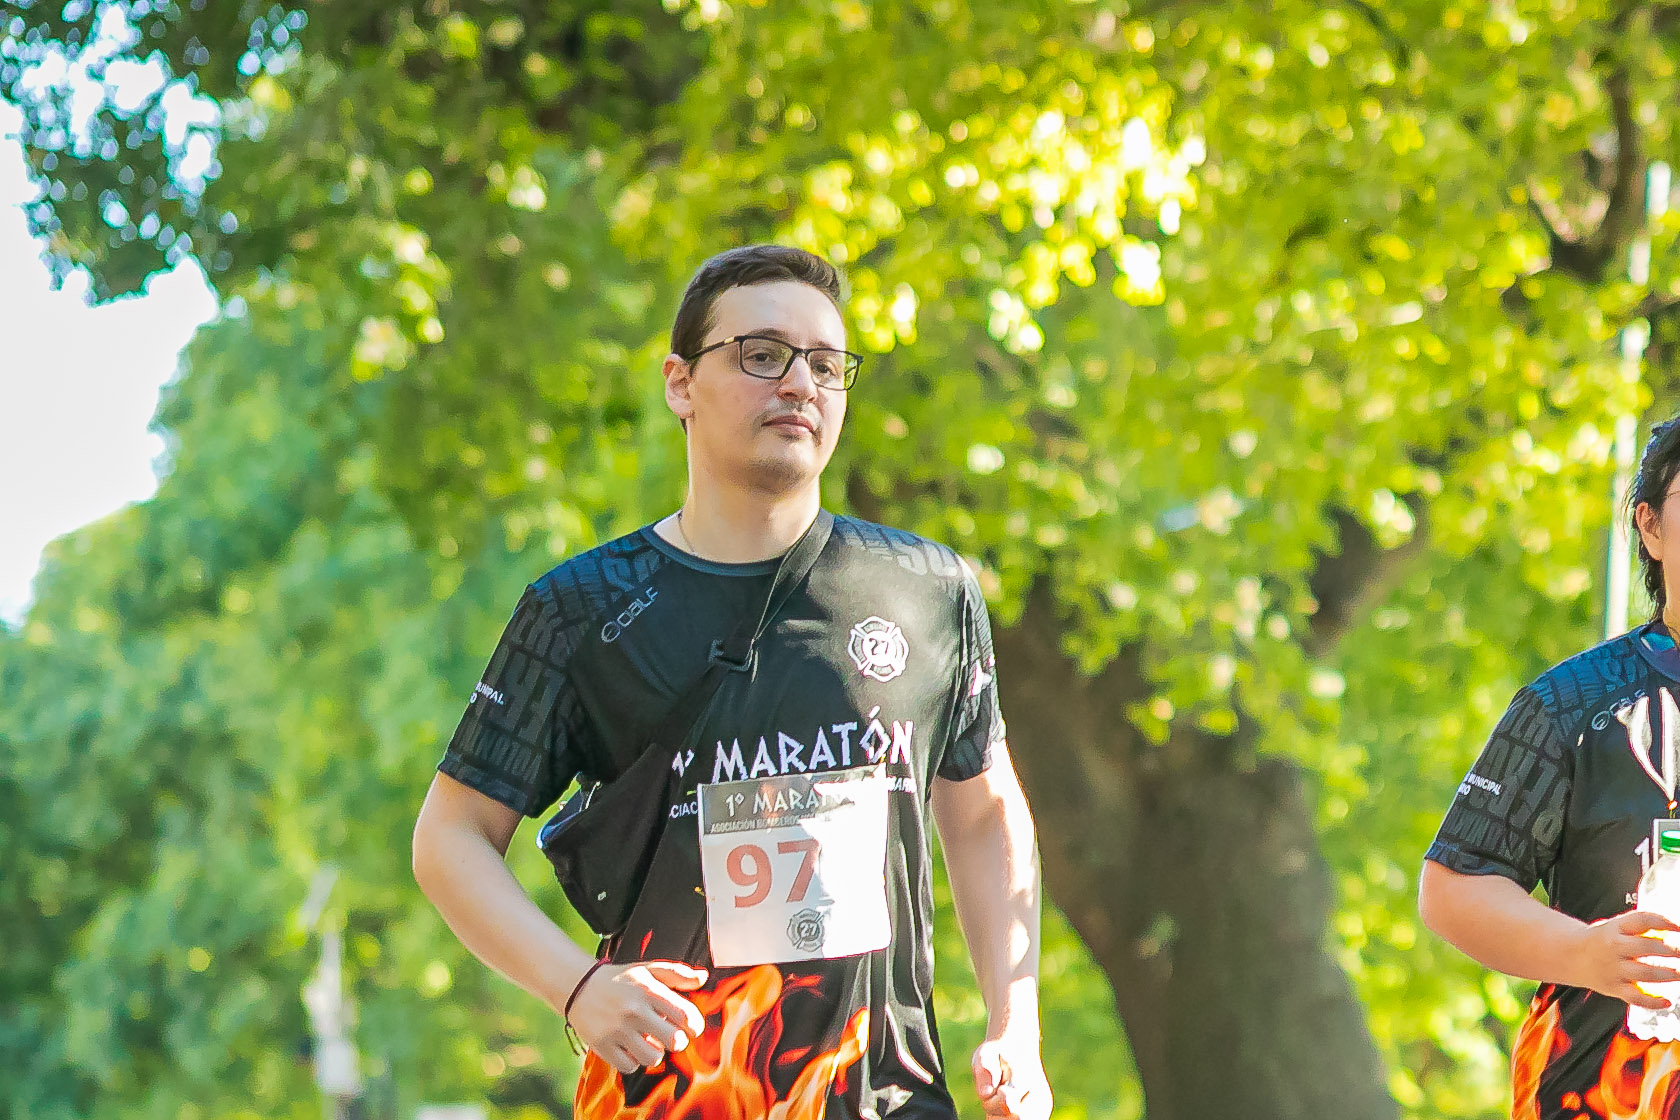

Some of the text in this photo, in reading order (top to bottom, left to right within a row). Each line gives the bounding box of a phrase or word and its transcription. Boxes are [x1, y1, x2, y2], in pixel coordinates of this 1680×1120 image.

[868, 637, 889, 655] 27
[712, 705, 914, 785] MARATÓN
[800, 922, 818, 938] 27
